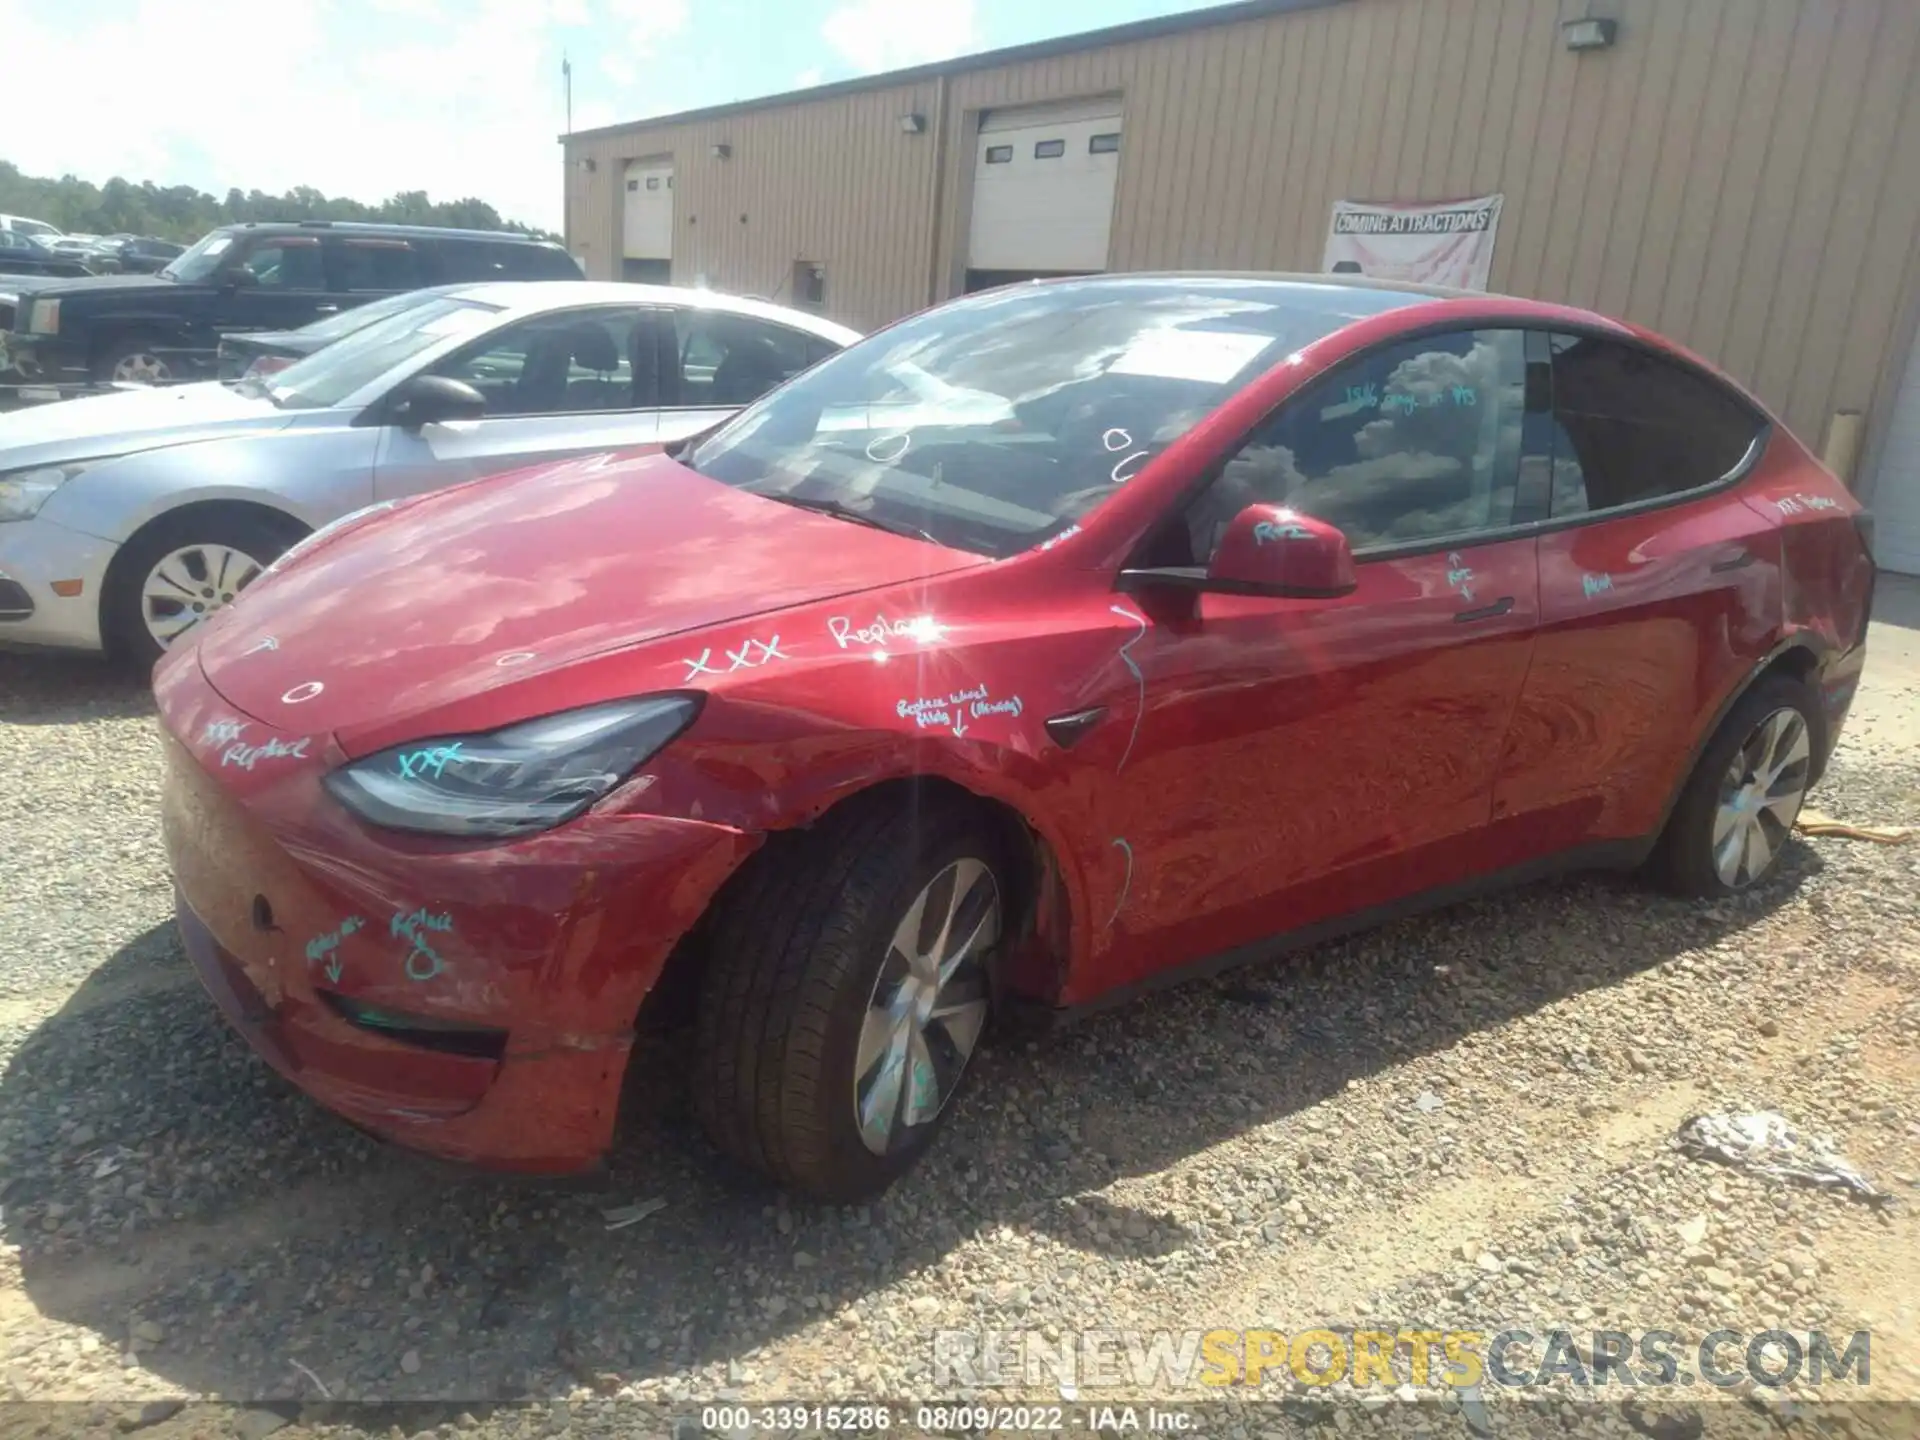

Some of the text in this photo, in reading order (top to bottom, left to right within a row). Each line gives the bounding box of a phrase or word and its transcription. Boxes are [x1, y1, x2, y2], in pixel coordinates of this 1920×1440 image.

[1337, 211, 1489, 233] COMING ATTRACTIONS
[827, 614, 938, 648] Repla
[221, 737, 311, 771] Replace
